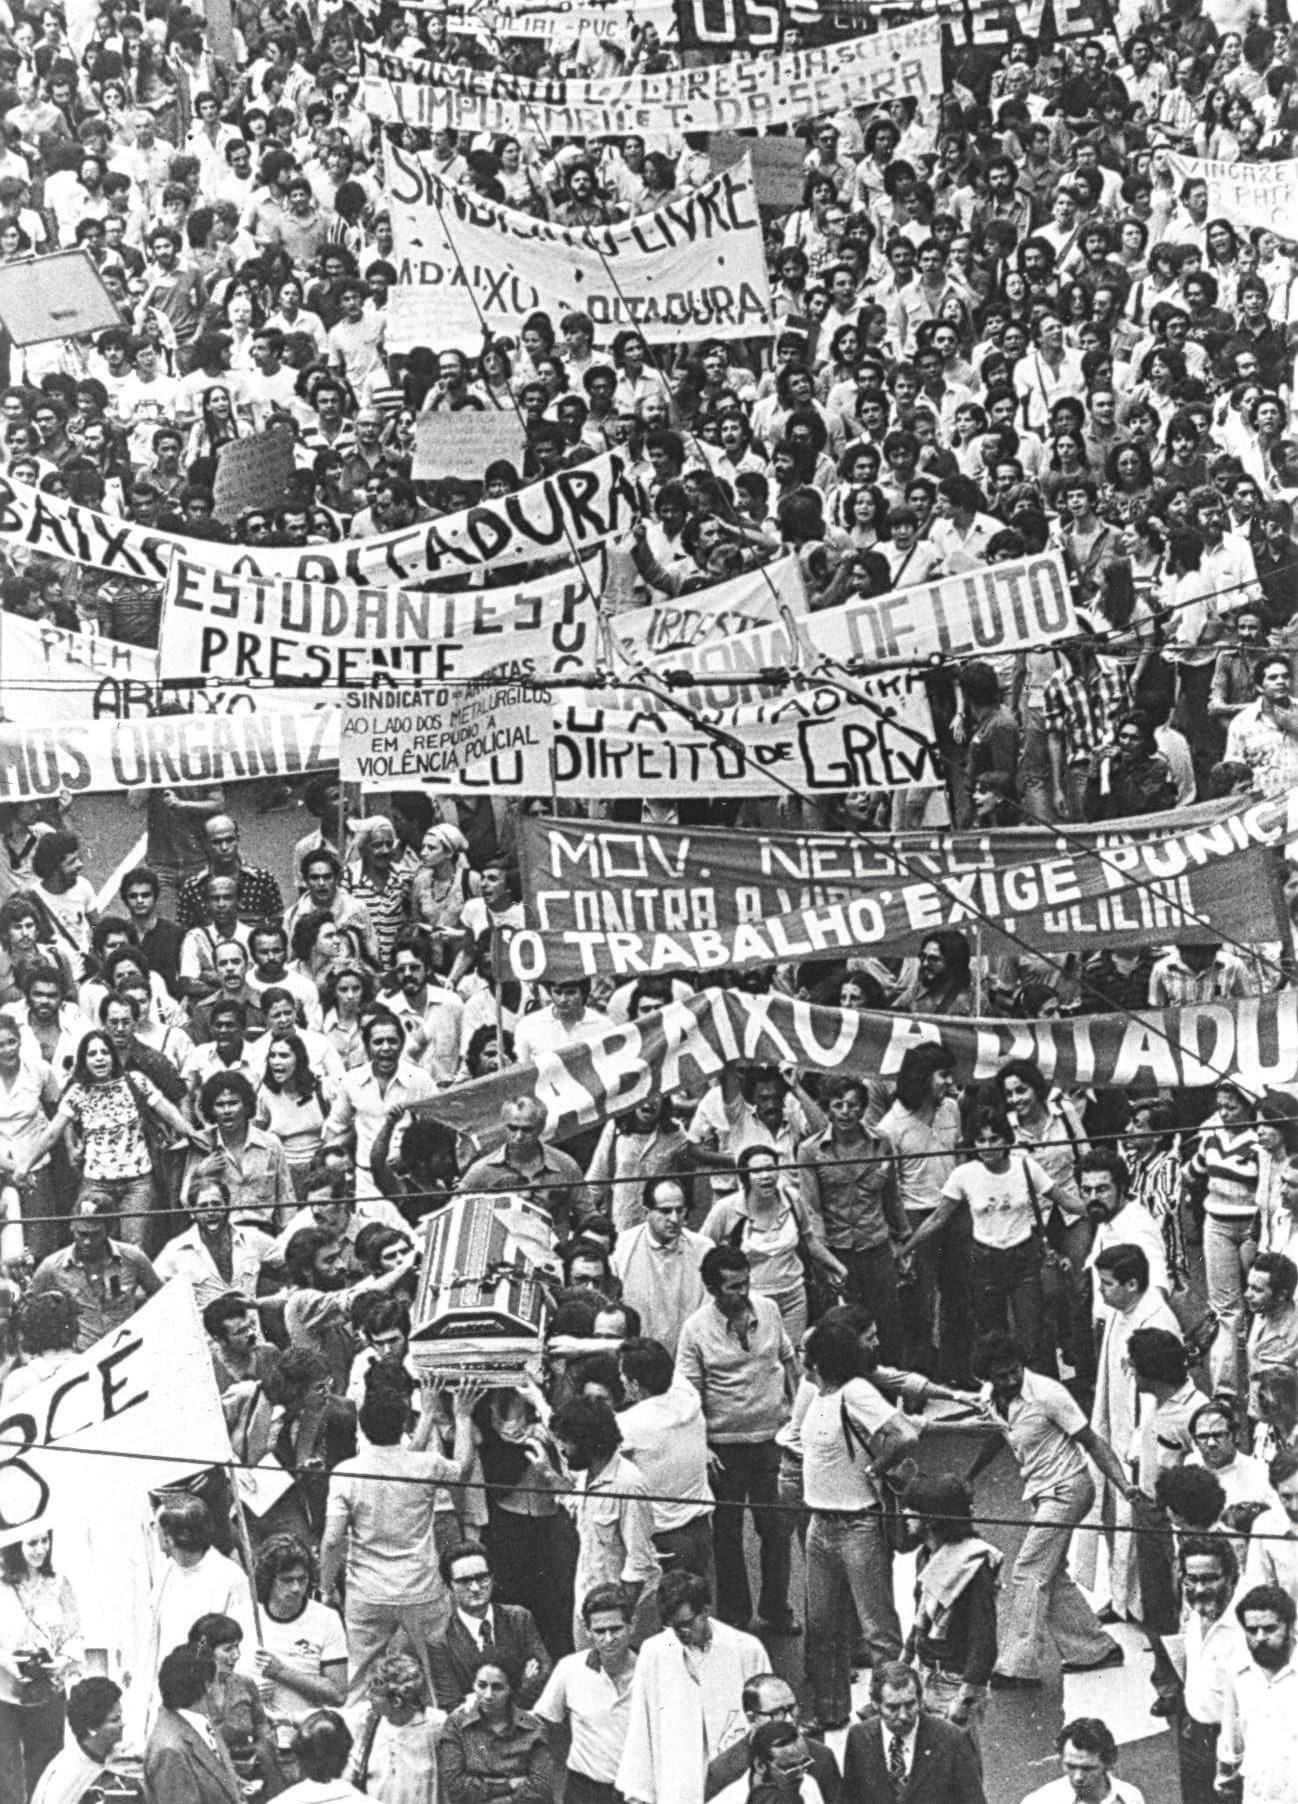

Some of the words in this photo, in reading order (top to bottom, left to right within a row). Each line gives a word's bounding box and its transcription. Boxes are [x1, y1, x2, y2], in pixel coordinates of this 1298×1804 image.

[577, 18, 618, 37] PUC
[173, 557, 543, 641] ESTUDANTES
[929, 558, 1070, 656] LUTO
[346, 688, 449, 709] SINDICATO
[343, 716, 369, 735] AO
[372, 716, 413, 735] LADO
[416, 714, 443, 733] DOS
[371, 736, 399, 752] EM
[356, 749, 460, 777] VIOLÊNCIA
[464, 724, 540, 764] POLICIAL
[554, 735, 746, 781] DIREITO
[754, 742, 794, 765] DE
[547, 830, 711, 879] MOV.
[757, 834, 995, 881] NEGRO
[901, 857, 1082, 930] EXIGE
[1099, 785, 1298, 890] PUNIÇ
[536, 886, 718, 932] CONTRA
[534, 986, 860, 1142] ABAIXO
[879, 1016, 942, 1074] A
